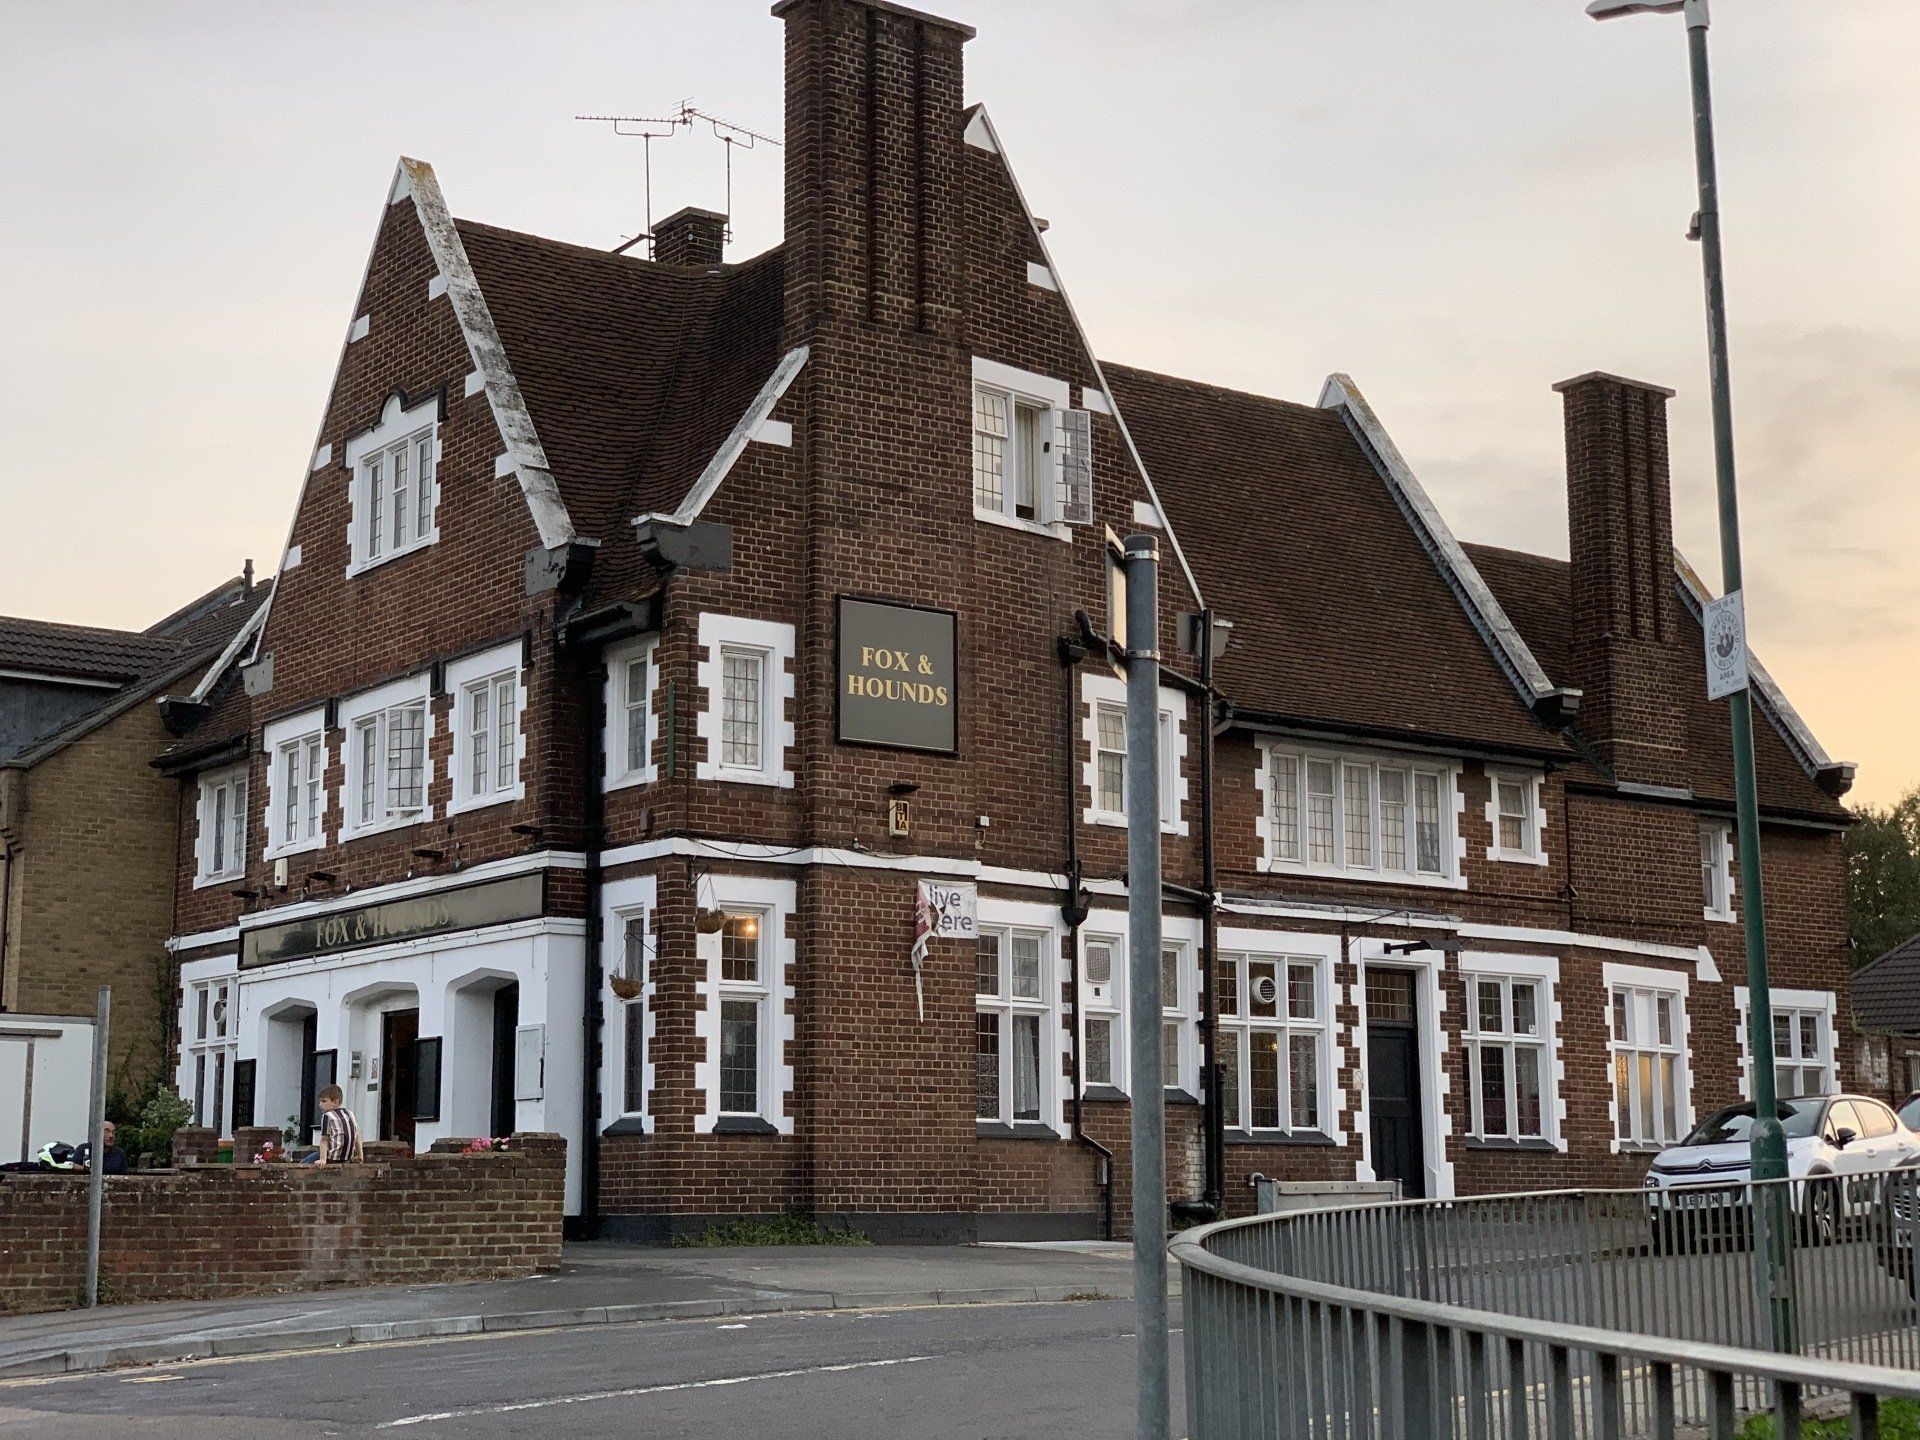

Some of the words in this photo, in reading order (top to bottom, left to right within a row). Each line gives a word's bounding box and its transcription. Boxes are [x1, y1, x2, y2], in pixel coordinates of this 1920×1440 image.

[1709, 602, 1722, 613] THIS
[862, 646, 910, 672] FOX
[917, 654, 934, 675] &
[1719, 669, 1735, 681] AREA
[847, 674, 948, 706] HOUNDS
[315, 915, 350, 948] FOX
[355, 912, 367, 940] &
[372, 895, 451, 938] HDS
[940, 915, 973, 931] ere
